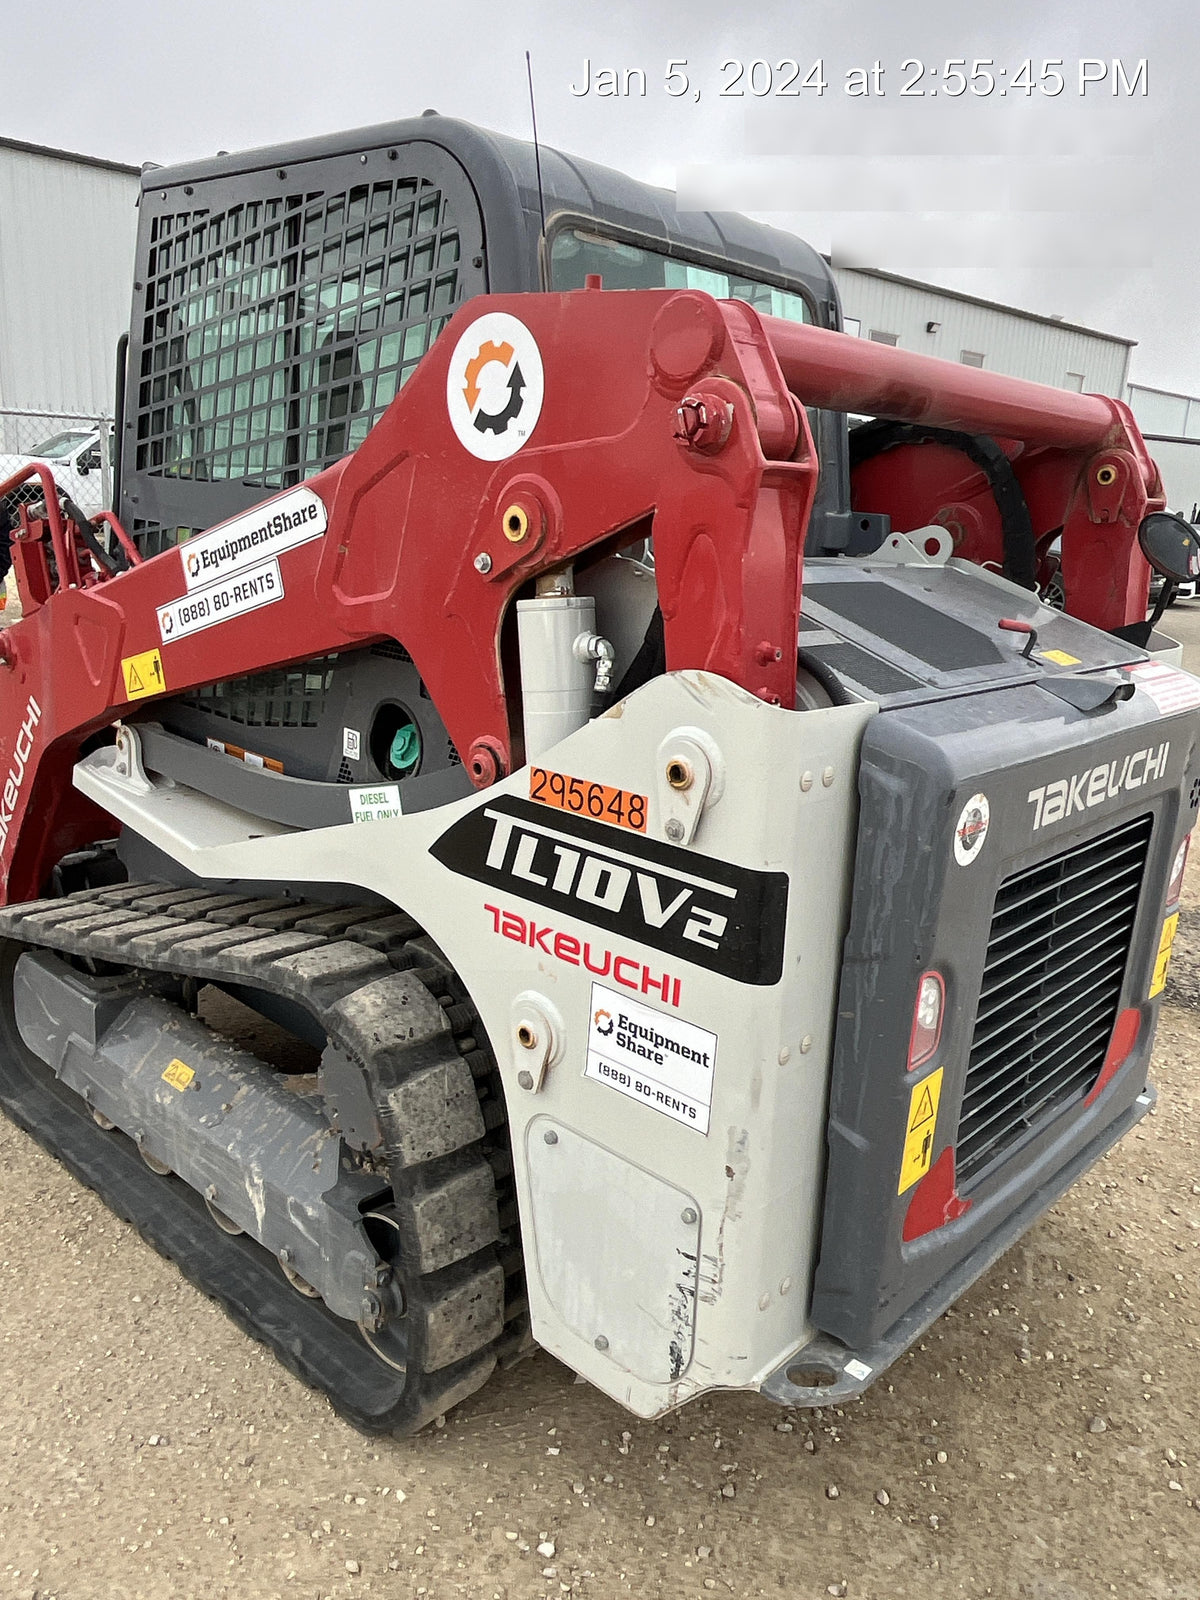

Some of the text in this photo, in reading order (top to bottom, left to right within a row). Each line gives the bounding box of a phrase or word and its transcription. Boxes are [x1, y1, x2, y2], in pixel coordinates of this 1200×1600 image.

[200, 503, 318, 568] EquipmentShare
[178, 572, 275, 626] (888) 80-RENTS
[360, 792, 389, 805] DIESEL
[531, 768, 645, 829] 295648
[1027, 741, 1170, 831] TAKEUCHI
[483, 808, 738, 950] TL10V2
[484, 903, 681, 1007] TAKEUCHI
[616, 1031, 664, 1065] Share
[617, 1013, 710, 1068] Equipment
[598, 1062, 697, 1119] (888) 80-RENTS
